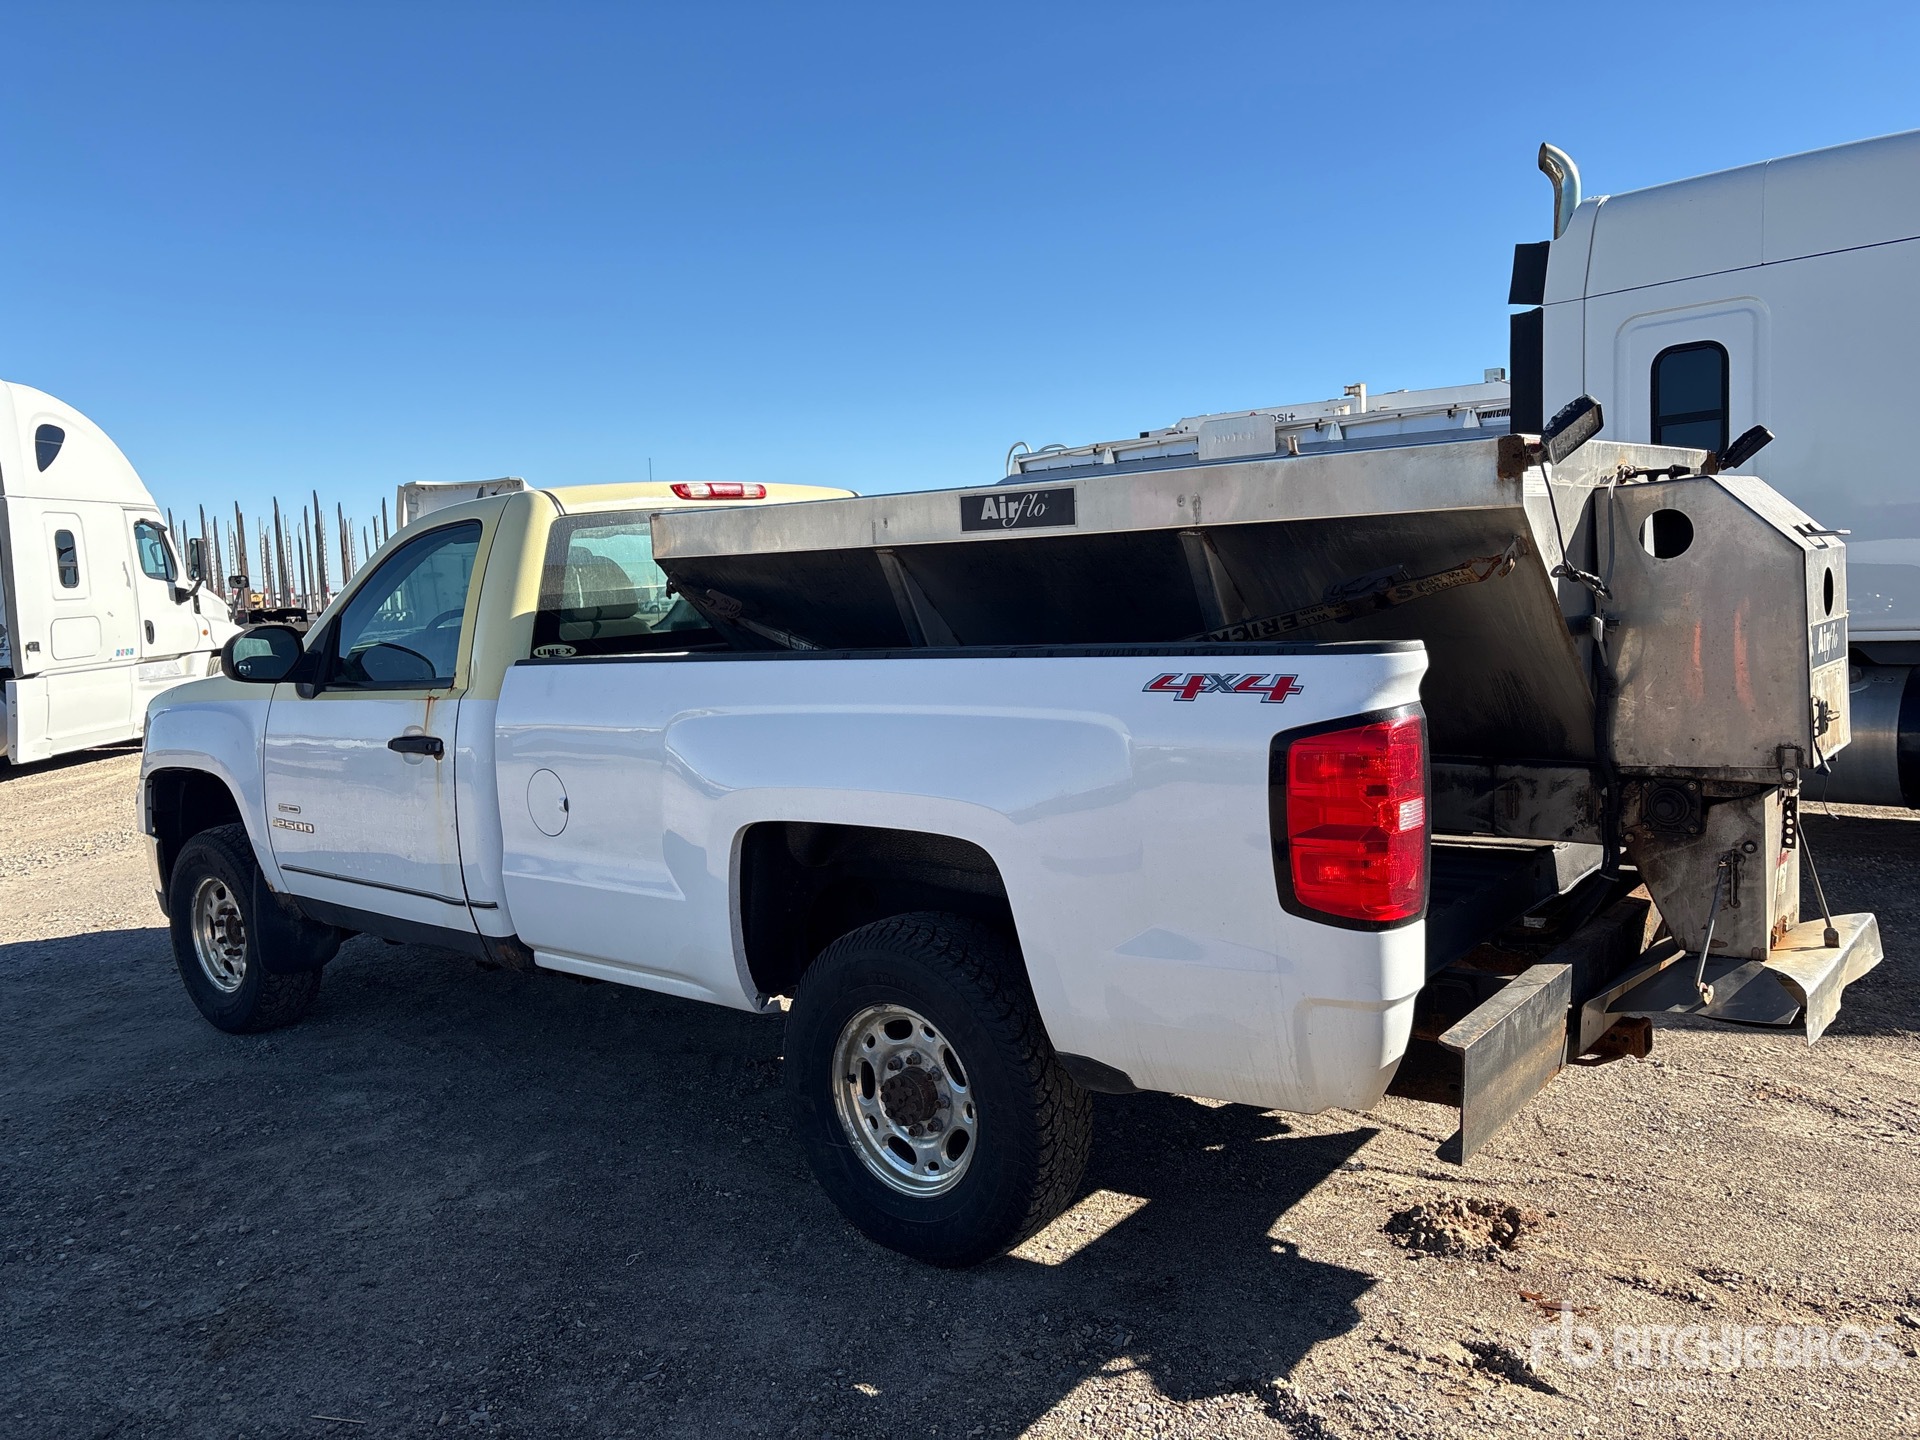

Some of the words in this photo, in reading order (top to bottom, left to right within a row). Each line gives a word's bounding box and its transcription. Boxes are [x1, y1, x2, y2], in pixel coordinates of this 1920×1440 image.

[980, 493, 1050, 528] Airflo
[537, 648, 572, 656] LINE-X
[1817, 622, 1839, 662] Airflo
[275, 818, 314, 833] 2500
